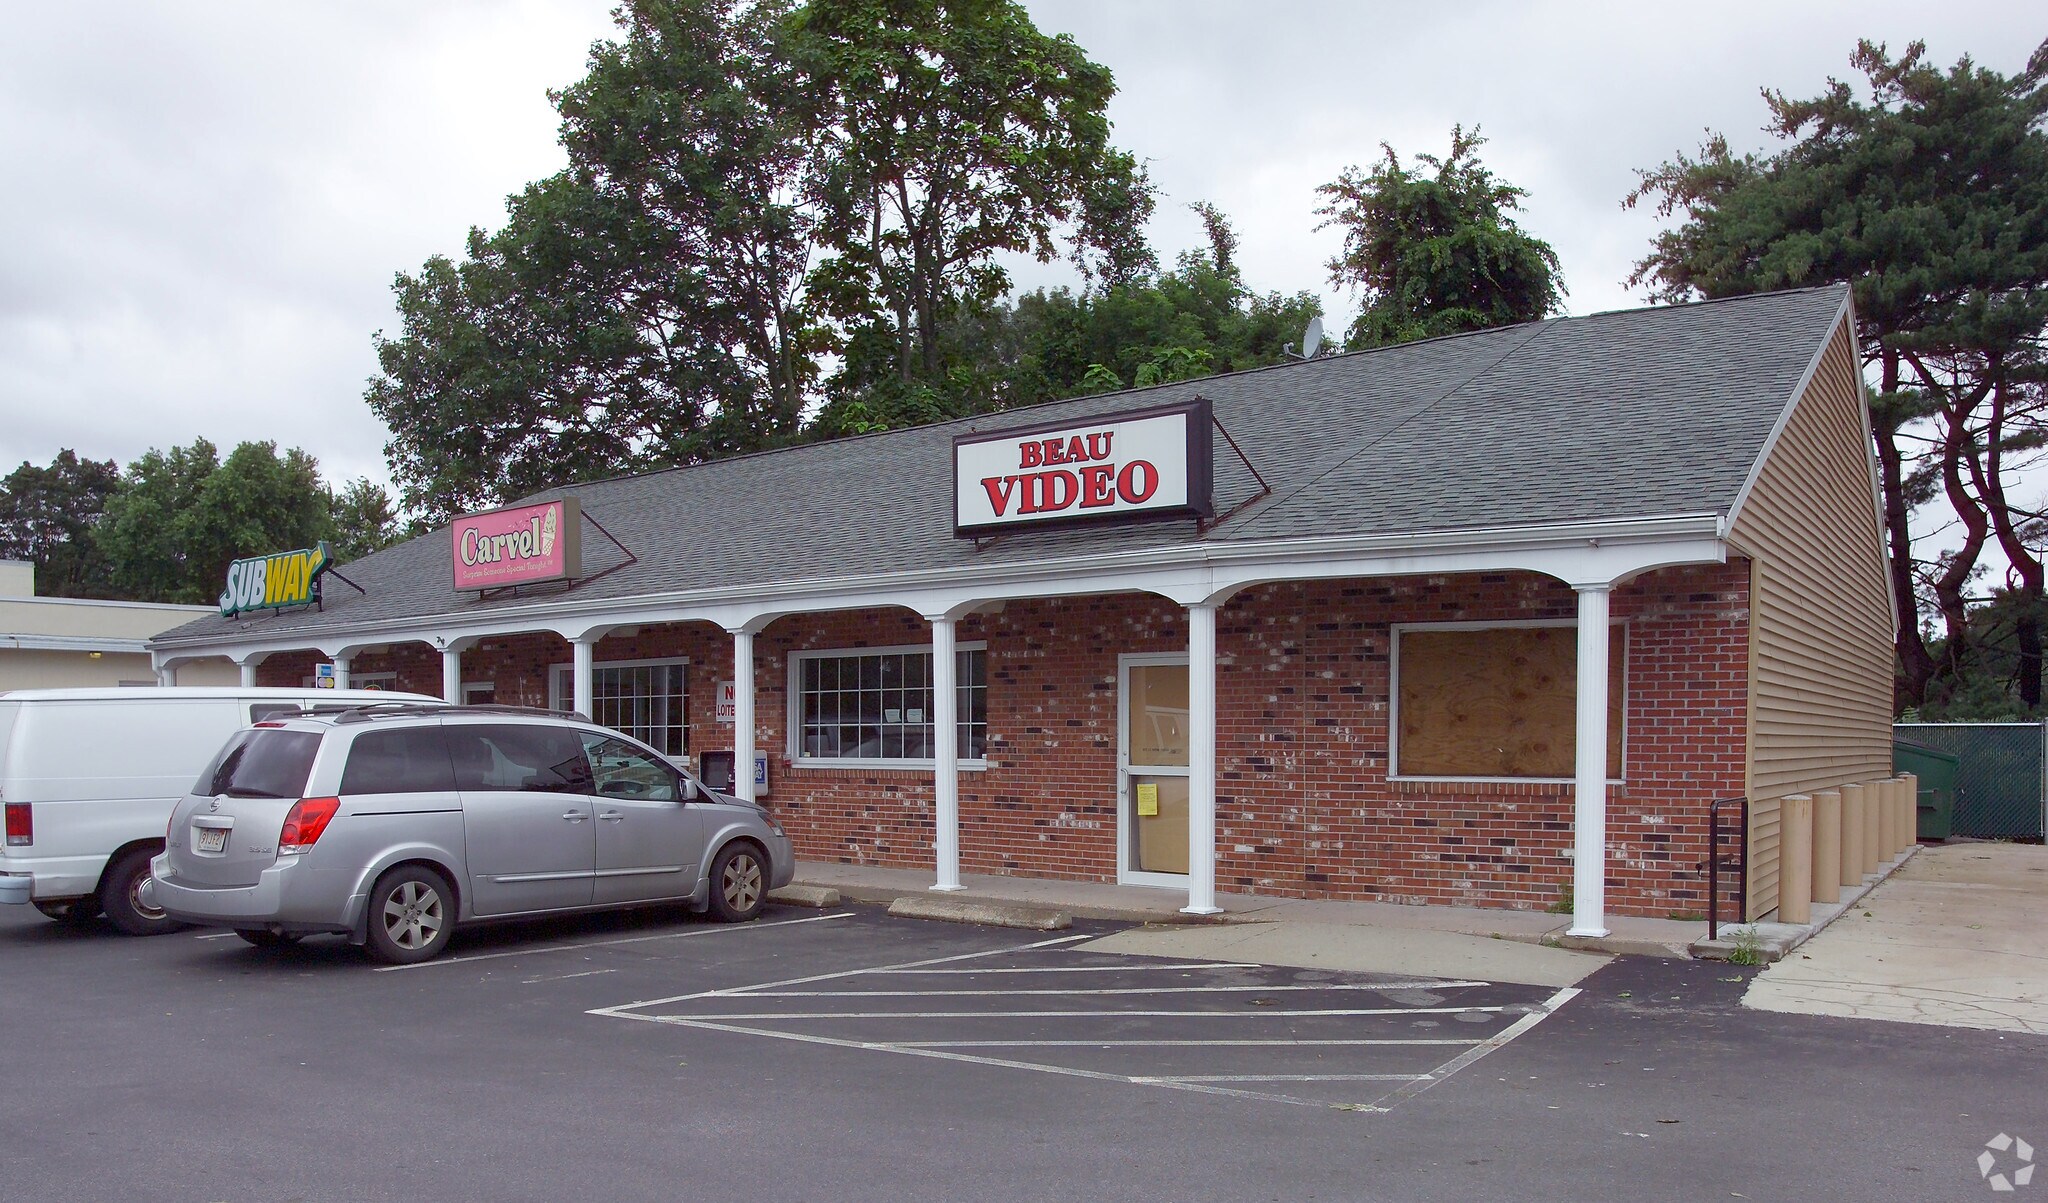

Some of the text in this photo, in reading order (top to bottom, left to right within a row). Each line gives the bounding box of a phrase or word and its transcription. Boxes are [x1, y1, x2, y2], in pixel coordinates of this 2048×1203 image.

[1019, 431, 1114, 469] BEAU
[981, 460, 1159, 517] VIDEO
[460, 516, 541, 567] Carvel
[220, 546, 322, 612] SUBWAY
[507, 564, 527, 575] Special
[718, 704, 735, 716] LOITE
[725, 686, 735, 699] N
